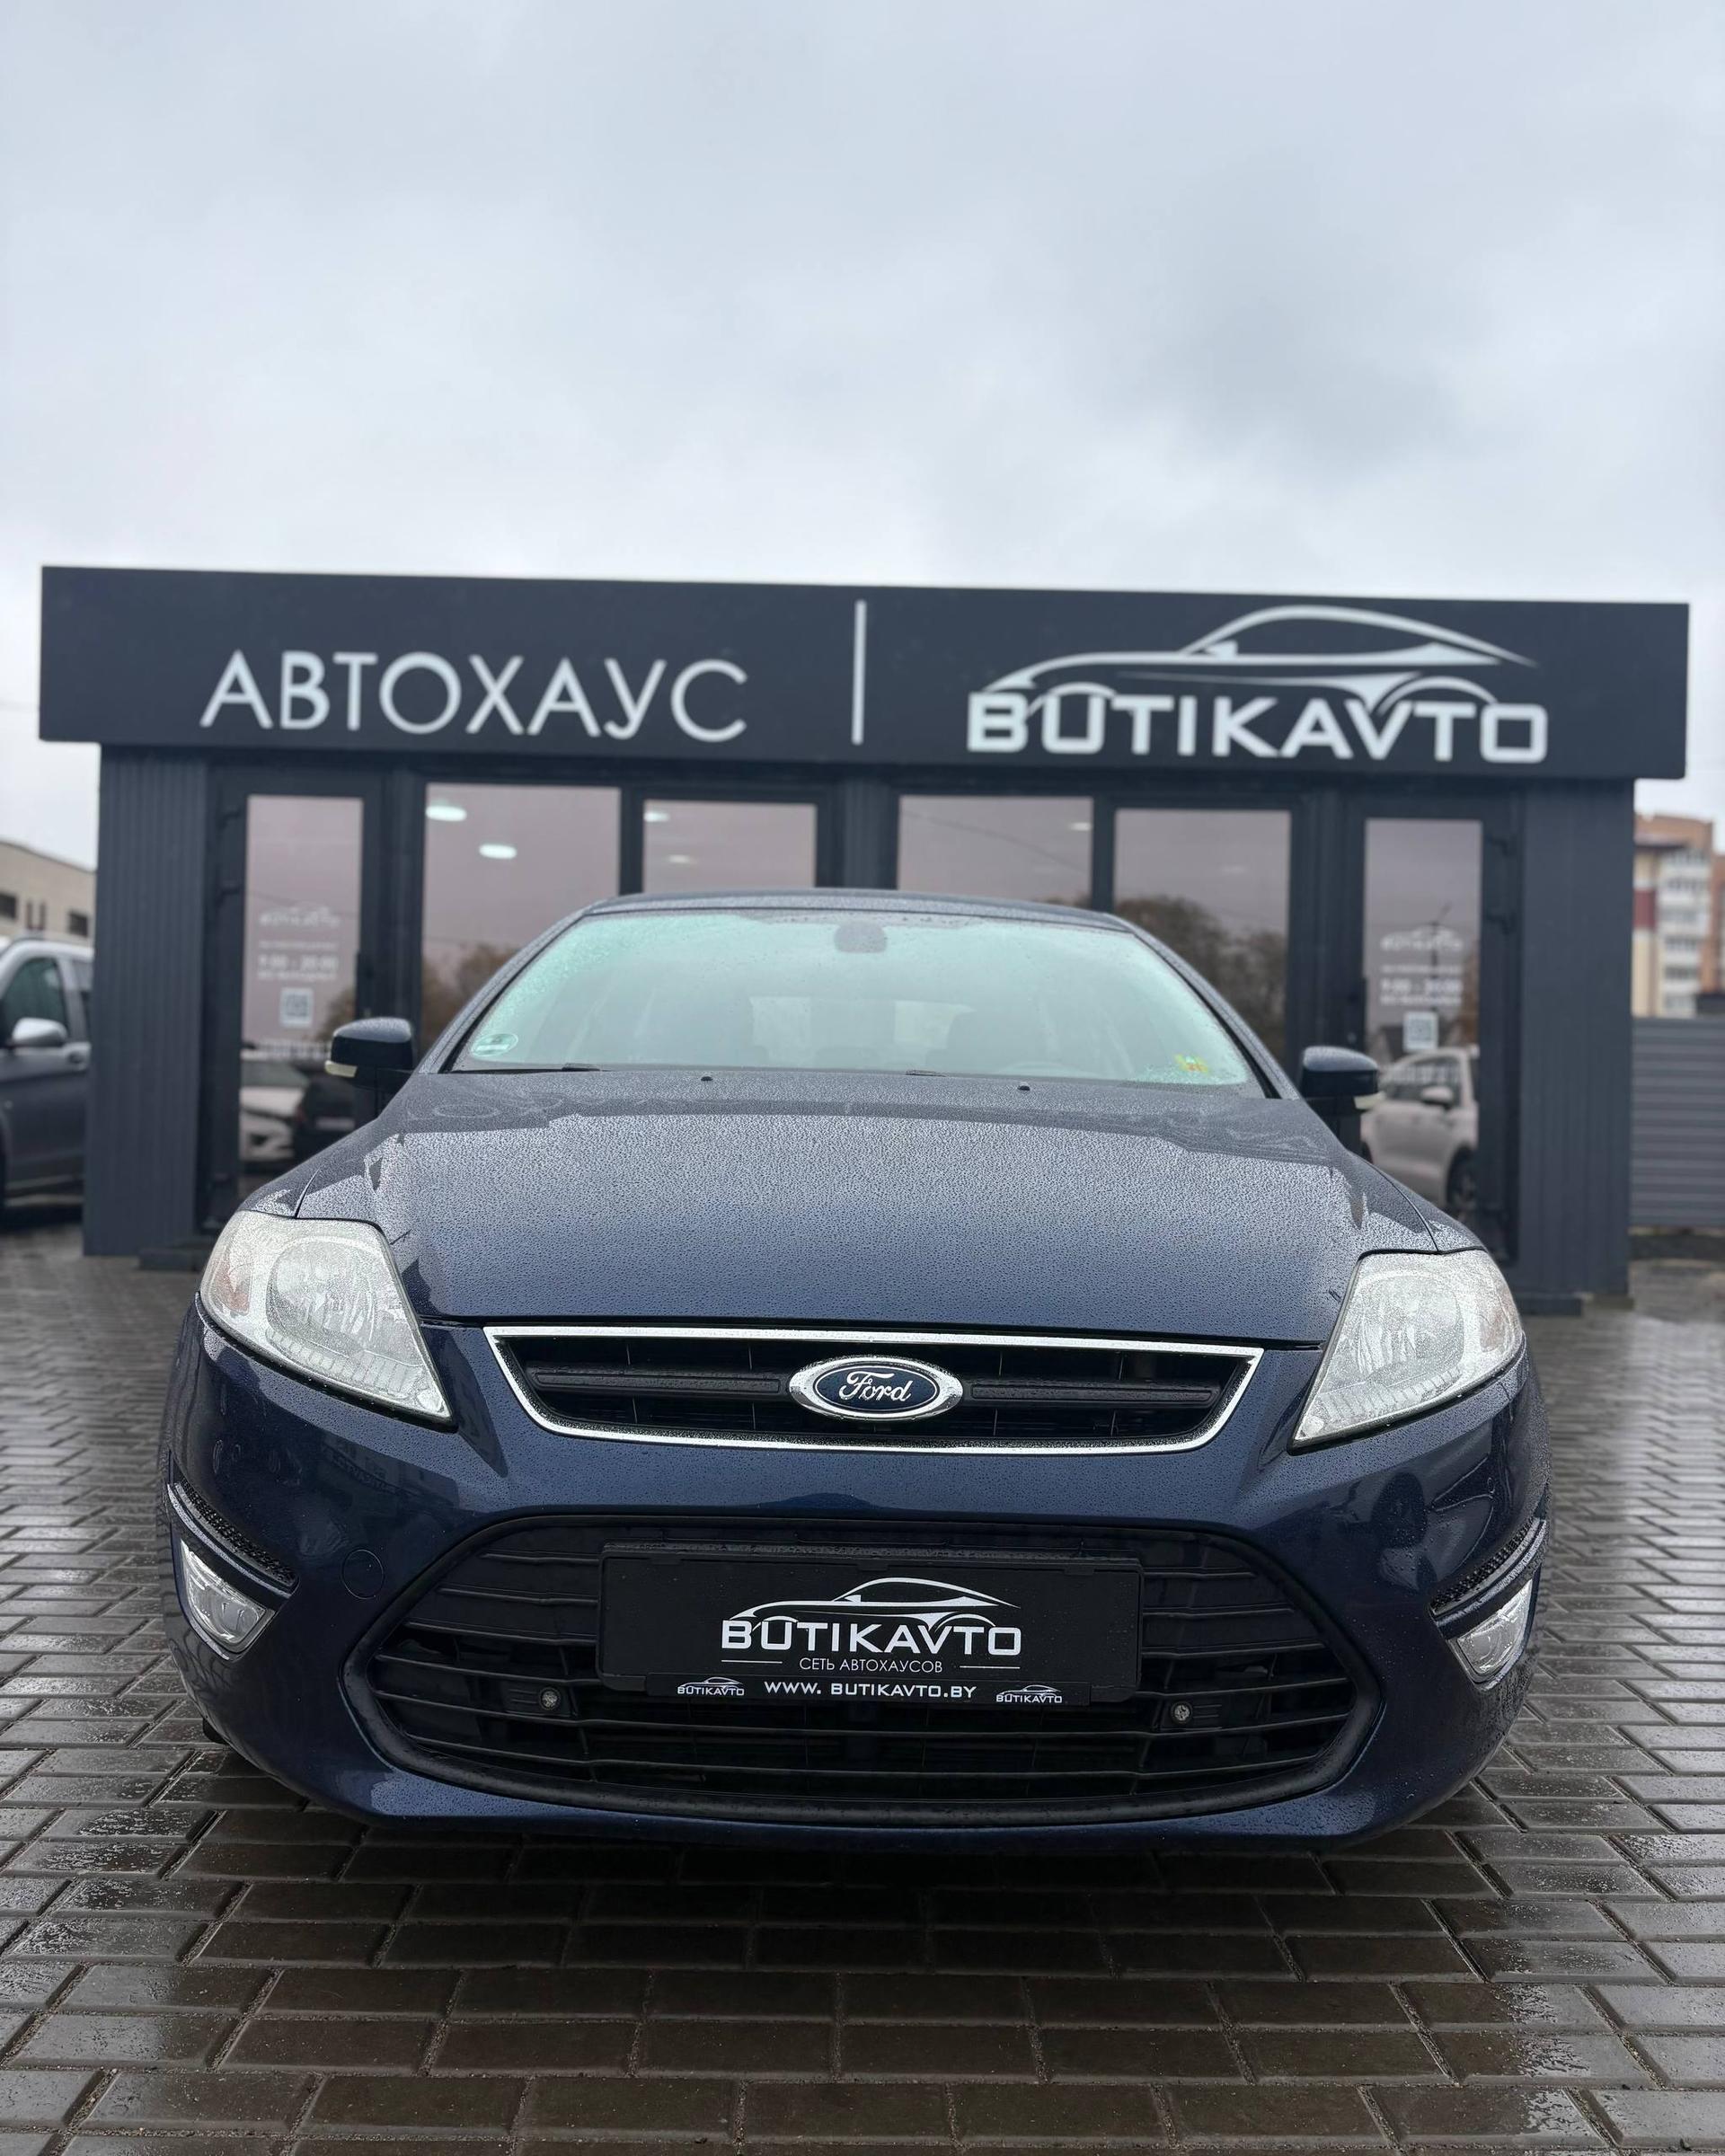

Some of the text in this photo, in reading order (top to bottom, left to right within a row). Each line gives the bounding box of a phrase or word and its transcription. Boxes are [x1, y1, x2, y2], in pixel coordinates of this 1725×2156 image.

[199, 649, 748, 743] АВТОХАУС
[967, 691, 1549, 764] BUTIKAVTO
[838, 1370, 914, 1402] Ford
[721, 1619, 1022, 1657] BUTIKAVTO
[799, 1657, 943, 1673] СЕТЬ АВТОХАУСОВ
[677, 1685, 745, 1696] BUTIKAVTO
[830, 1683, 977, 1699] BUTIKAVTO.BY
[995, 1694, 1063, 1703] BUTIKAVTO
